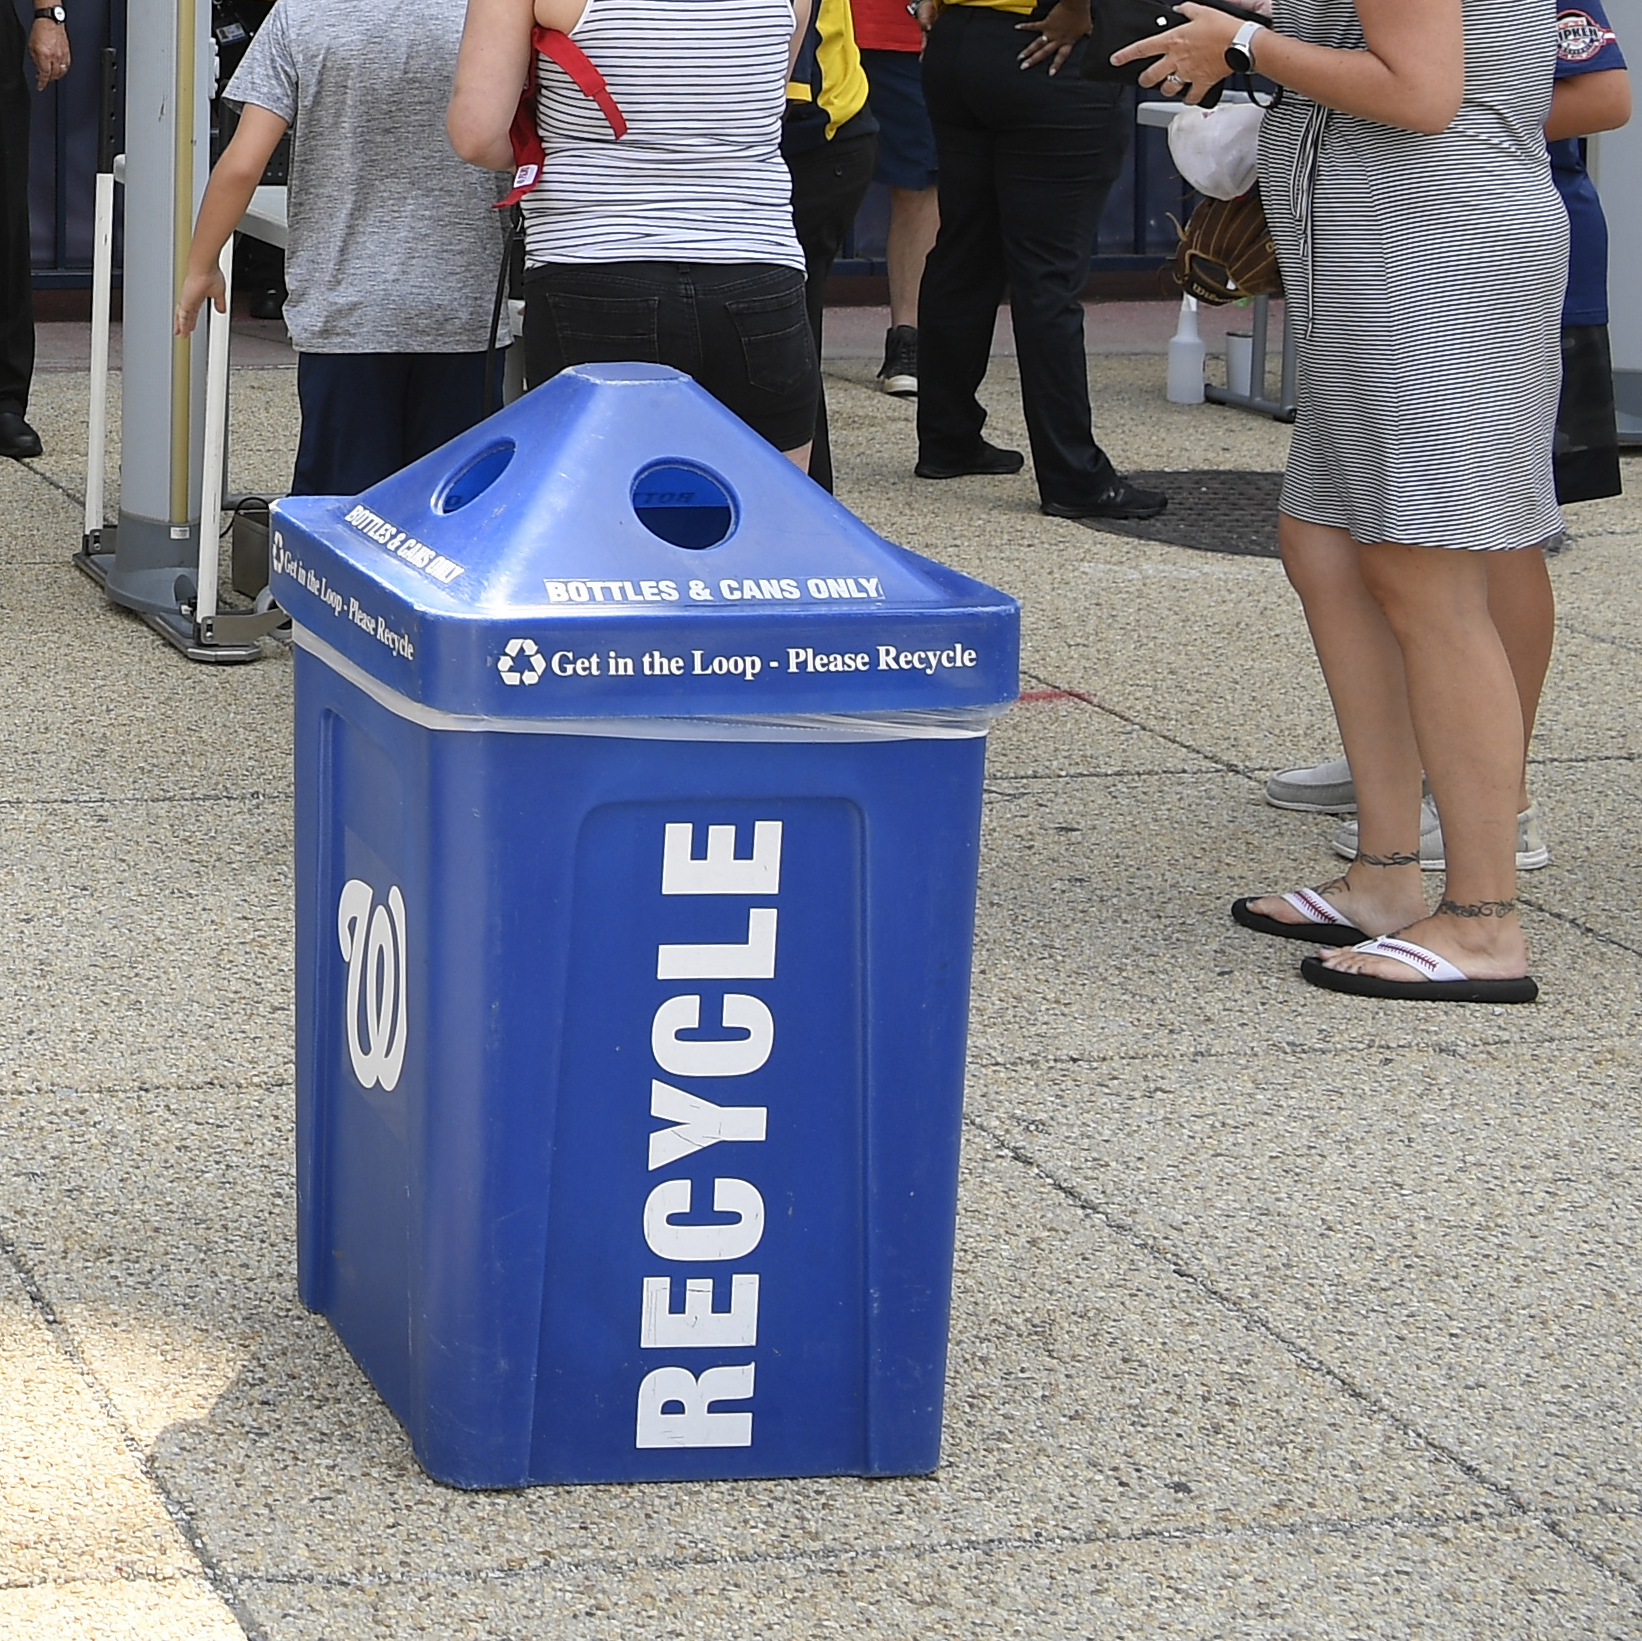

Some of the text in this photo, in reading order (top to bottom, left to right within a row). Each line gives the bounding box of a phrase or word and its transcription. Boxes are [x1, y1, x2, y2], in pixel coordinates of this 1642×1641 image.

[344, 504, 466, 584] BOTTLES & CANS ONLY
[284, 551, 298, 579] Get
[298, 560, 306, 584] in
[307, 569, 320, 595] the
[320, 578, 343, 617] Loop
[348, 597, 376, 635] Please
[377, 616, 415, 660] Recycle
[549, 577, 881, 603] BOTTLES & CANS ONLY
[551, 651, 600, 677] Get
[608, 650, 635, 676] in
[642, 650, 684, 676] the
[691, 649, 762, 680] Loop
[786, 647, 870, 674] Please
[877, 643, 977, 675] Recycle
[636, 819, 783, 1449] RECYCLE
